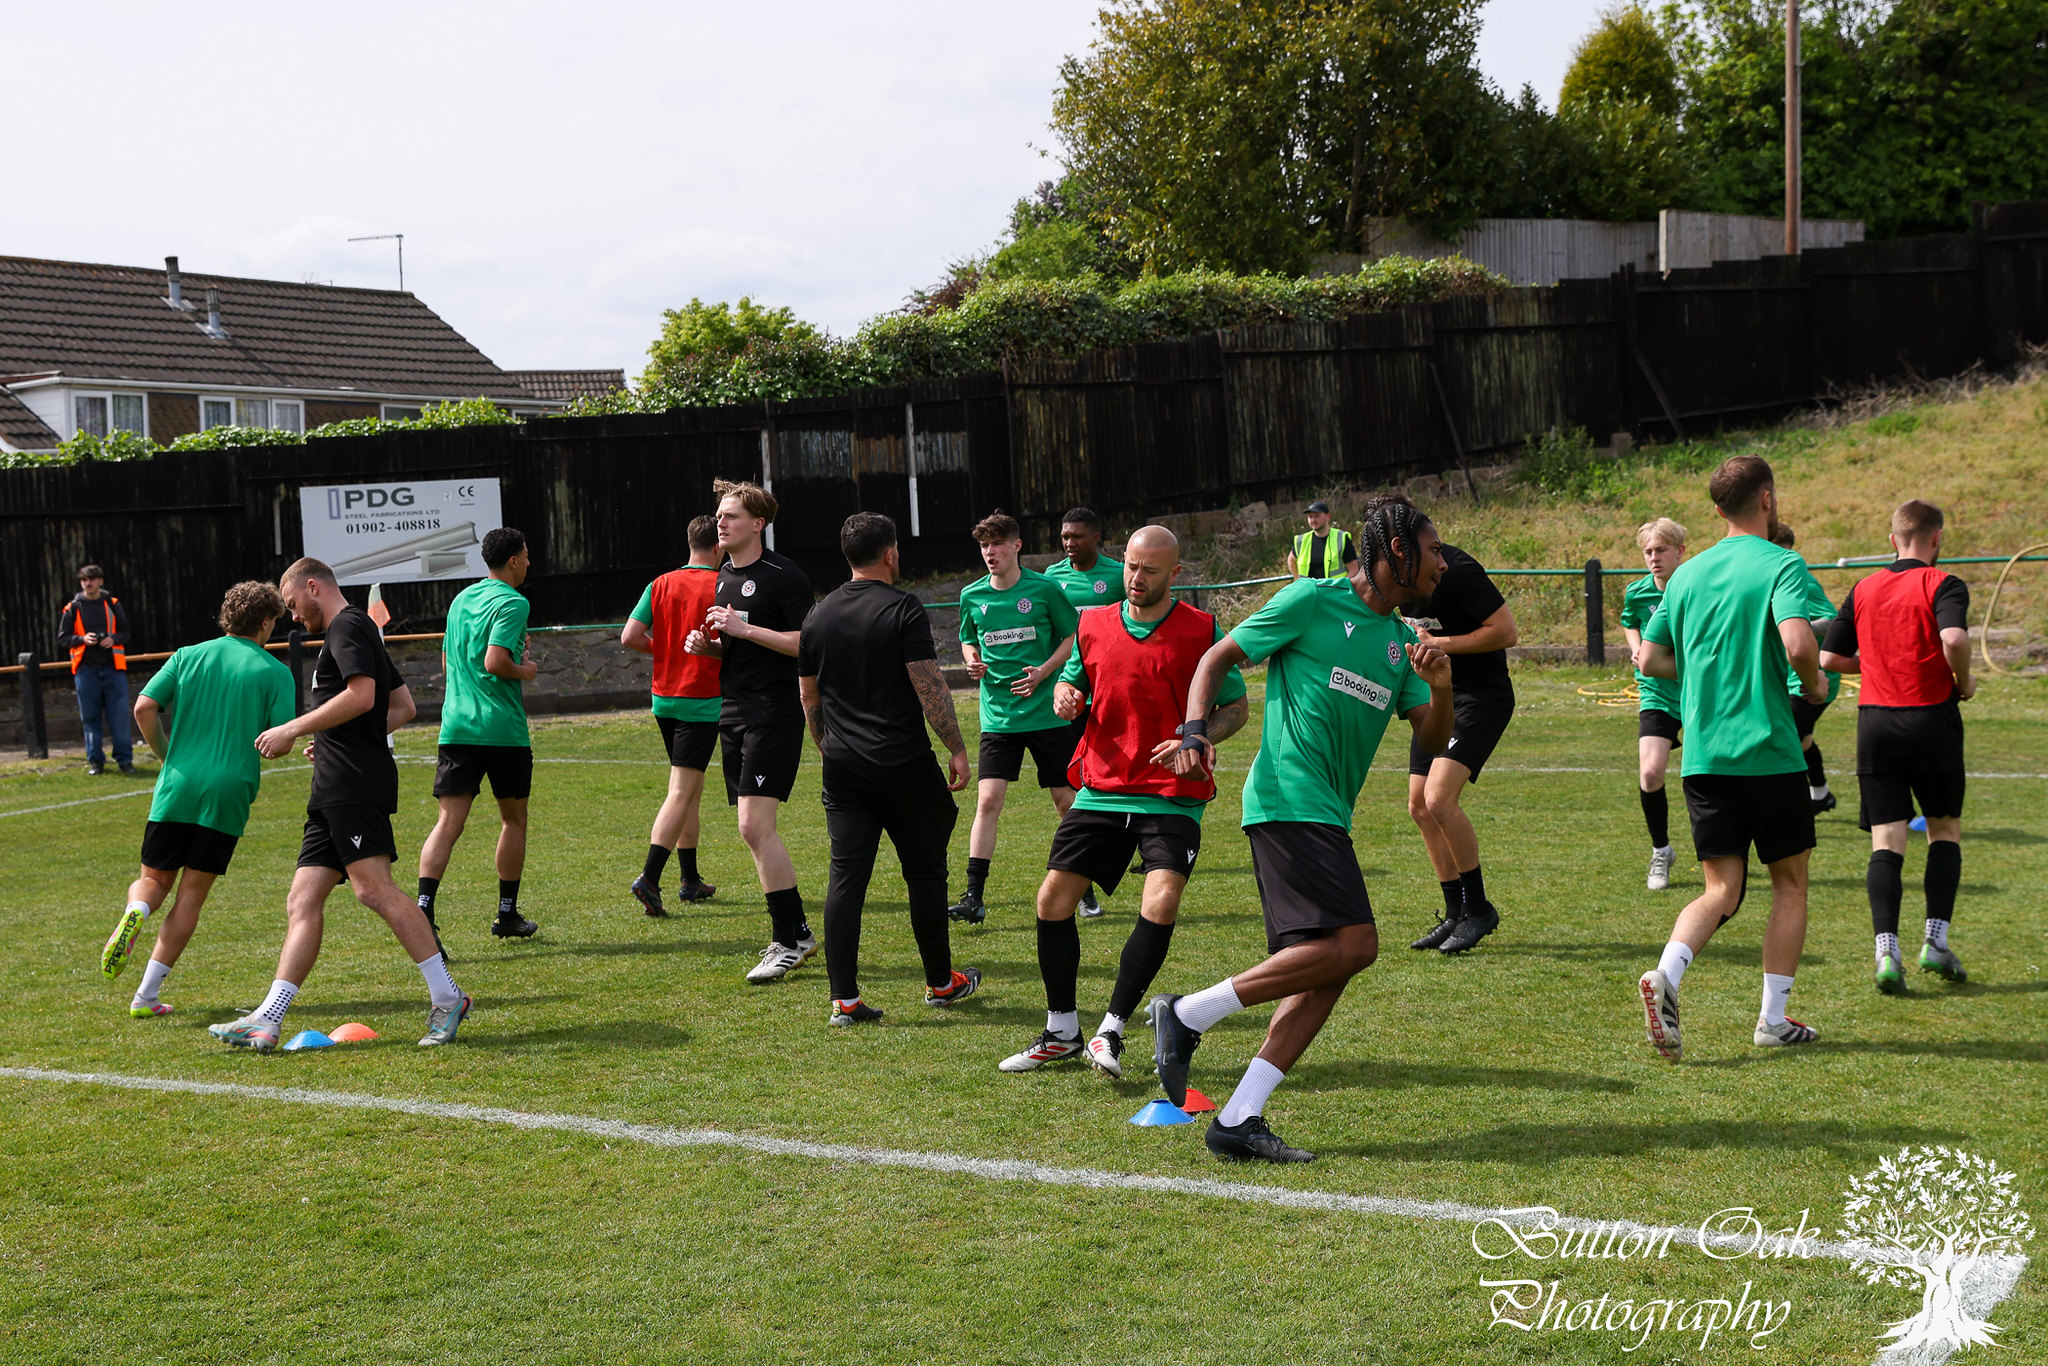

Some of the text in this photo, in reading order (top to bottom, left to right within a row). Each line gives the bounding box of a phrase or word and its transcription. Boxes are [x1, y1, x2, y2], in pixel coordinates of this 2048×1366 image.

[344, 487, 415, 509] PDG
[371, 510, 423, 518] FABRICATIONS
[346, 519, 440, 534] 01902-408818
[105, 911, 140, 974] PREDATOR
[1641, 979, 1671, 1057] PREDATOR
